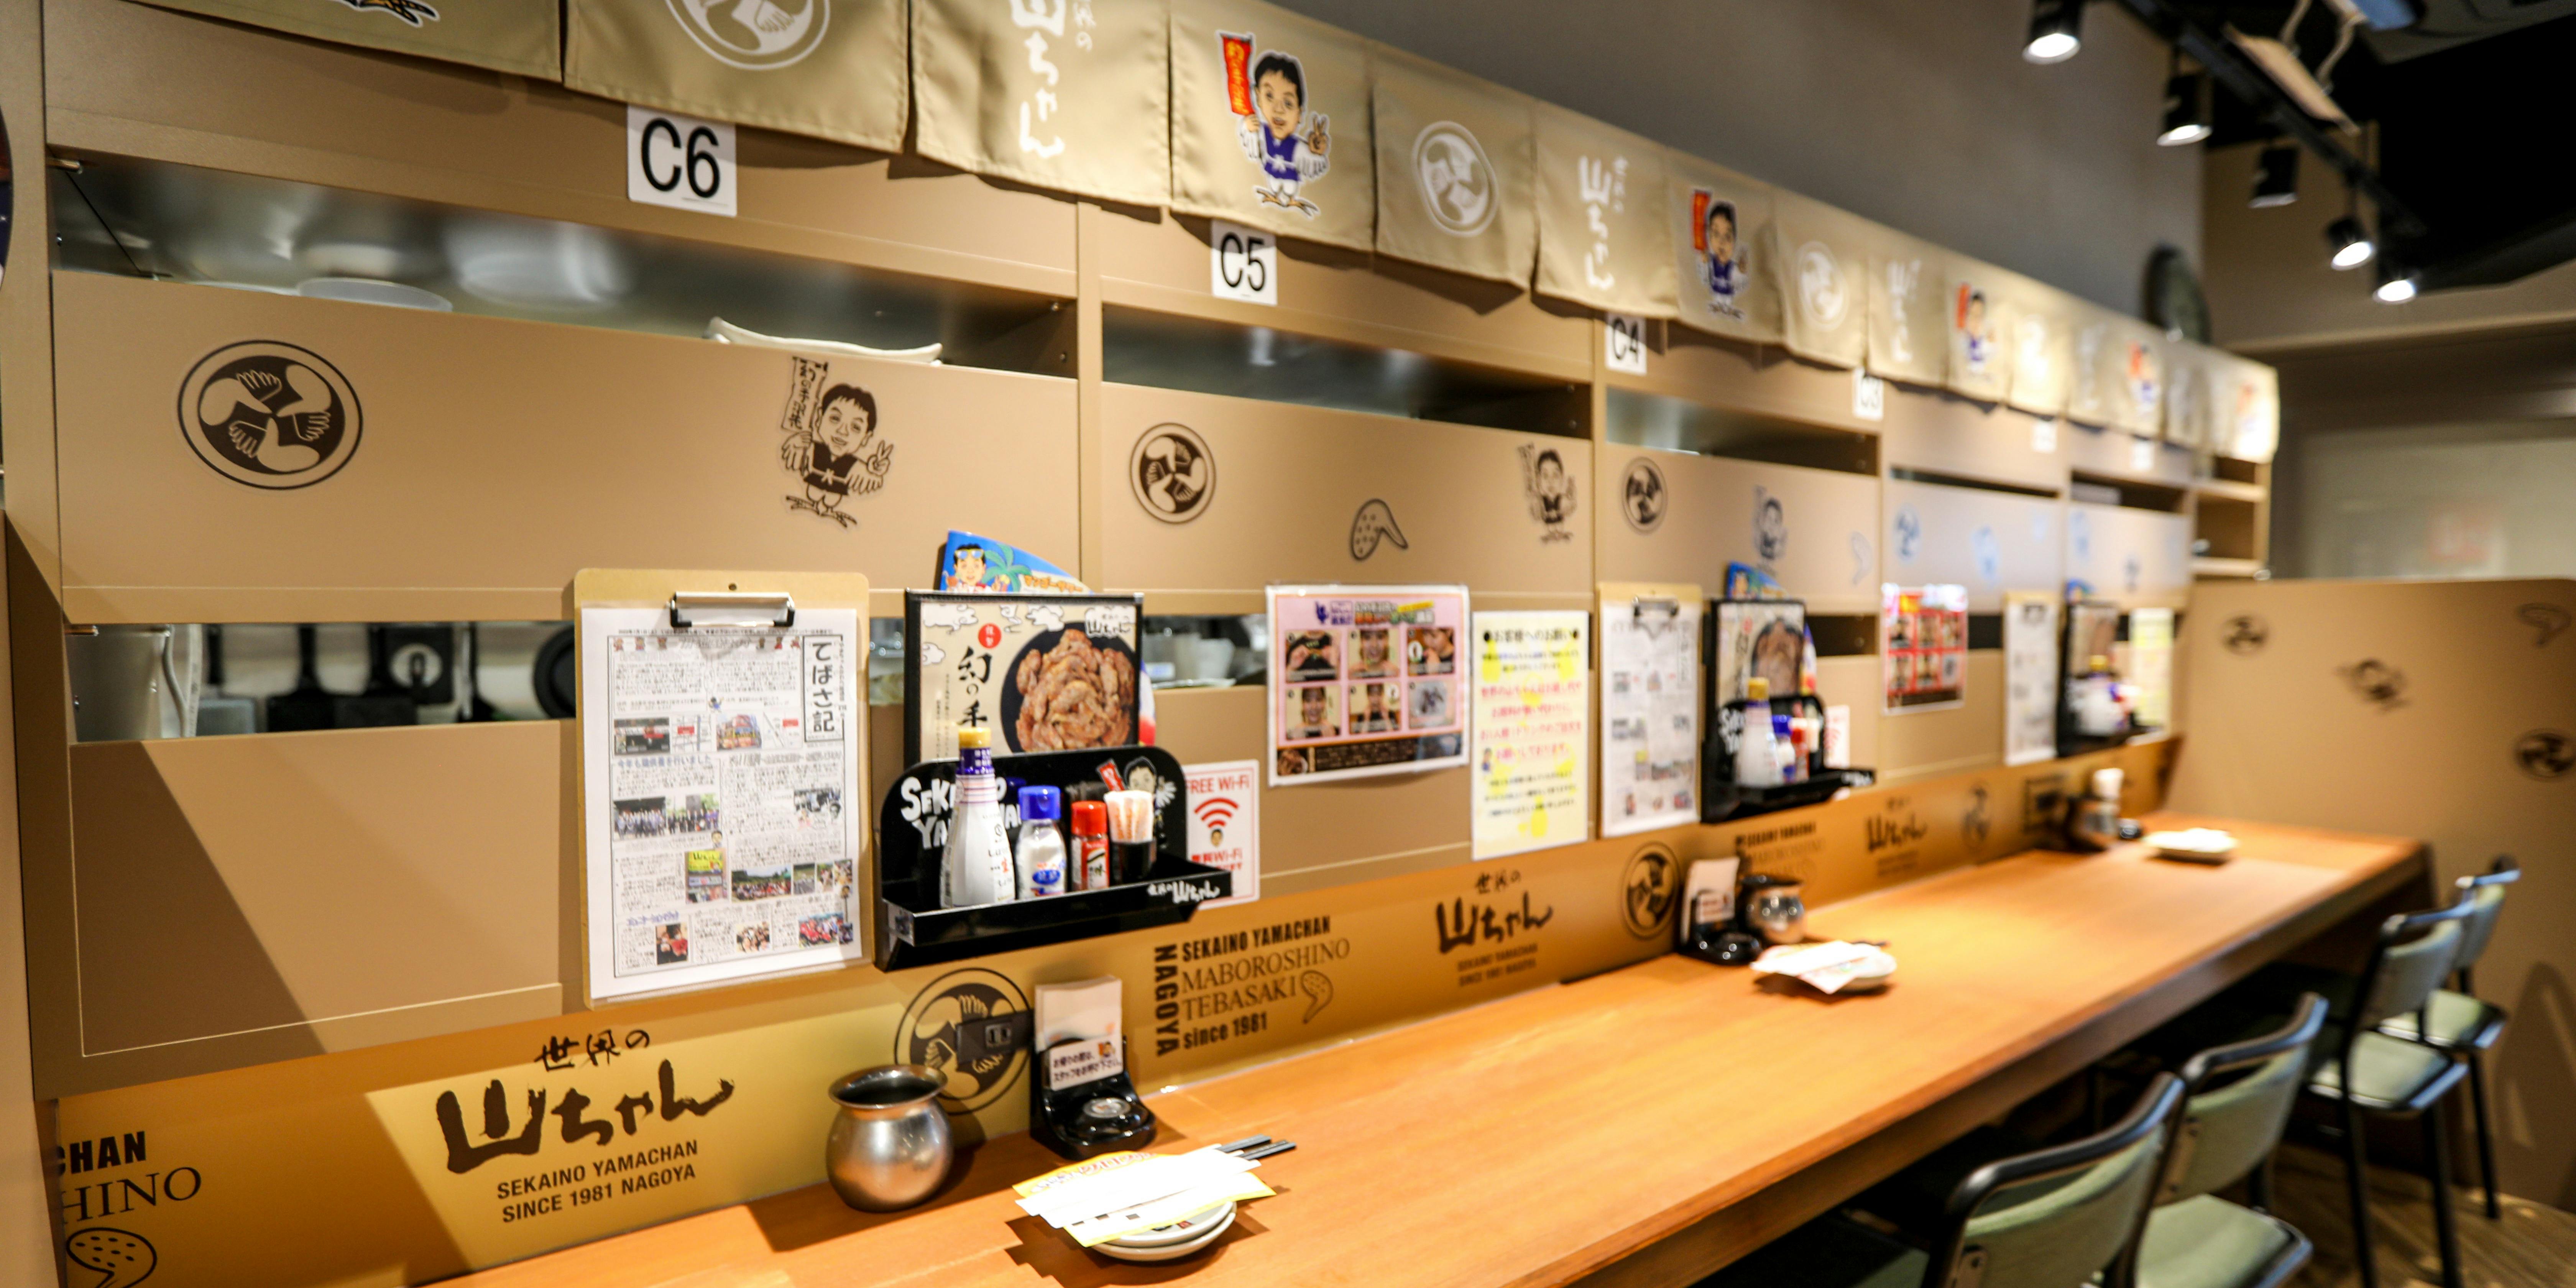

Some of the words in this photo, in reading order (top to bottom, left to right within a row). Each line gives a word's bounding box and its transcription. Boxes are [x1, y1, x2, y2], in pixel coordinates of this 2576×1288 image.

[641, 117, 721, 199] C6
[1221, 232, 1266, 291] C5
[1612, 317, 1640, 364] C4
[812, 641, 835, 733] てばさ記
[901, 777, 1007, 821] SEKO
[1475, 869, 1521, 895] 世界の
[1182, 931, 1249, 962] SEKAINO
[1252, 915, 1331, 948] YAMACHAN
[1436, 890, 1554, 954] 山ちゃん
[1182, 938, 1350, 993] MABOROSHINO
[1154, 943, 1180, 1057] NAGOYA
[1182, 975, 1296, 1021] TEBASAKI
[534, 1029, 651, 1072] 世界の
[1183, 1024, 1229, 1050] since
[1233, 1011, 1268, 1036] 1981
[436, 1058, 735, 1174] 山ちゃん
[497, 1165, 585, 1199] SEKAINO
[593, 1139, 698, 1178] YAMACHAN
[503, 1194, 562, 1223] SINCE
[570, 1184, 613, 1206] 1981
[621, 1163, 696, 1196] NAGOYA
